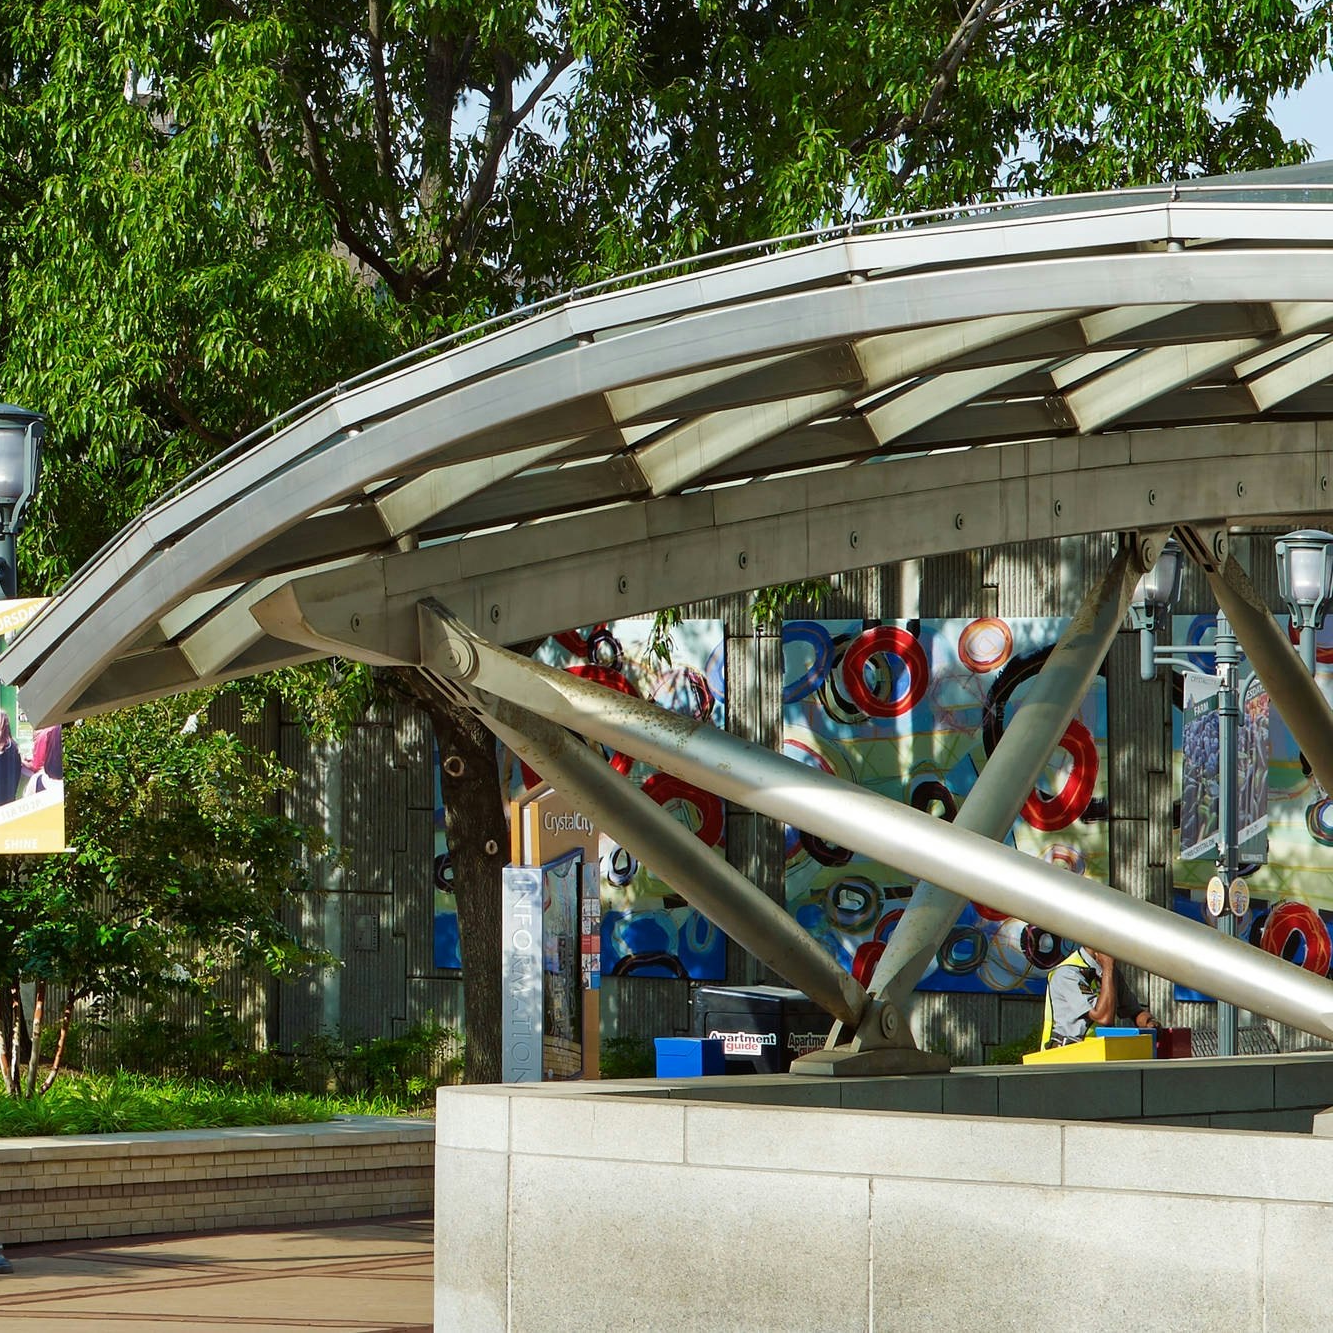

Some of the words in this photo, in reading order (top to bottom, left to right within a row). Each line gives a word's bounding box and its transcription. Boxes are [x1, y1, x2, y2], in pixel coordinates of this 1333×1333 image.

[1194, 701, 1209, 716] FARM
[544, 811, 594, 836] CrystalCity
[5, 839, 38, 851] SHINE
[511, 879, 533, 1083] INFORMATION
[726, 1042, 759, 1052] guide
[789, 1034, 828, 1049] Apartme
